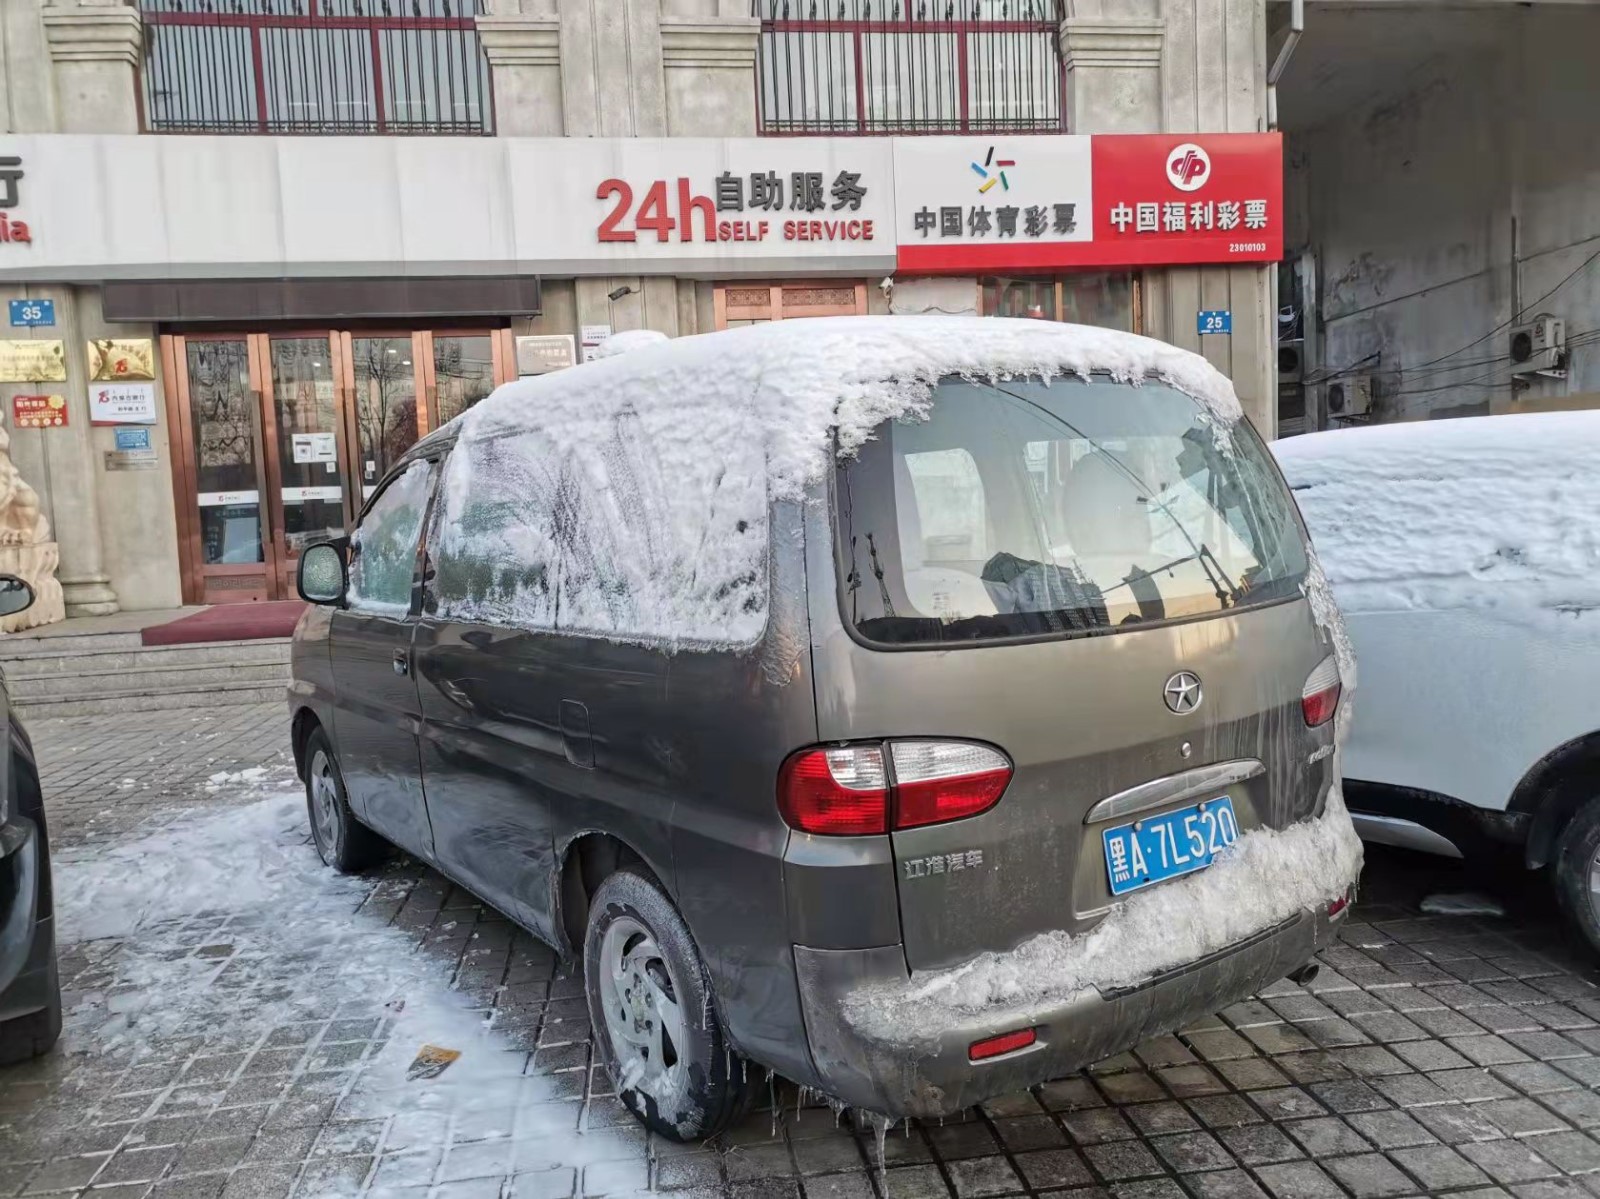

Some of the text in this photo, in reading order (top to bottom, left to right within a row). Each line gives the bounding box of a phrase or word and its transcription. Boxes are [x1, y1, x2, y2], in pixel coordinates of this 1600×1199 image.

[715, 170, 867, 213] 自助服务
[596, 176, 717, 243] 24h
[914, 203, 1077, 239] 中国体育彩票
[1110, 199, 1268, 234] 中国福利彩票
[0, 211, 32, 245] ia
[718, 219, 874, 242] SELF SERVICE
[1229, 242, 1267, 253] 23010103
[22, 306, 42, 320] 35
[1206, 316, 1223, 330] 25
[1109, 806, 1237, 883] 黑A·7L520
[904, 849, 983, 880] 江淮汽车
